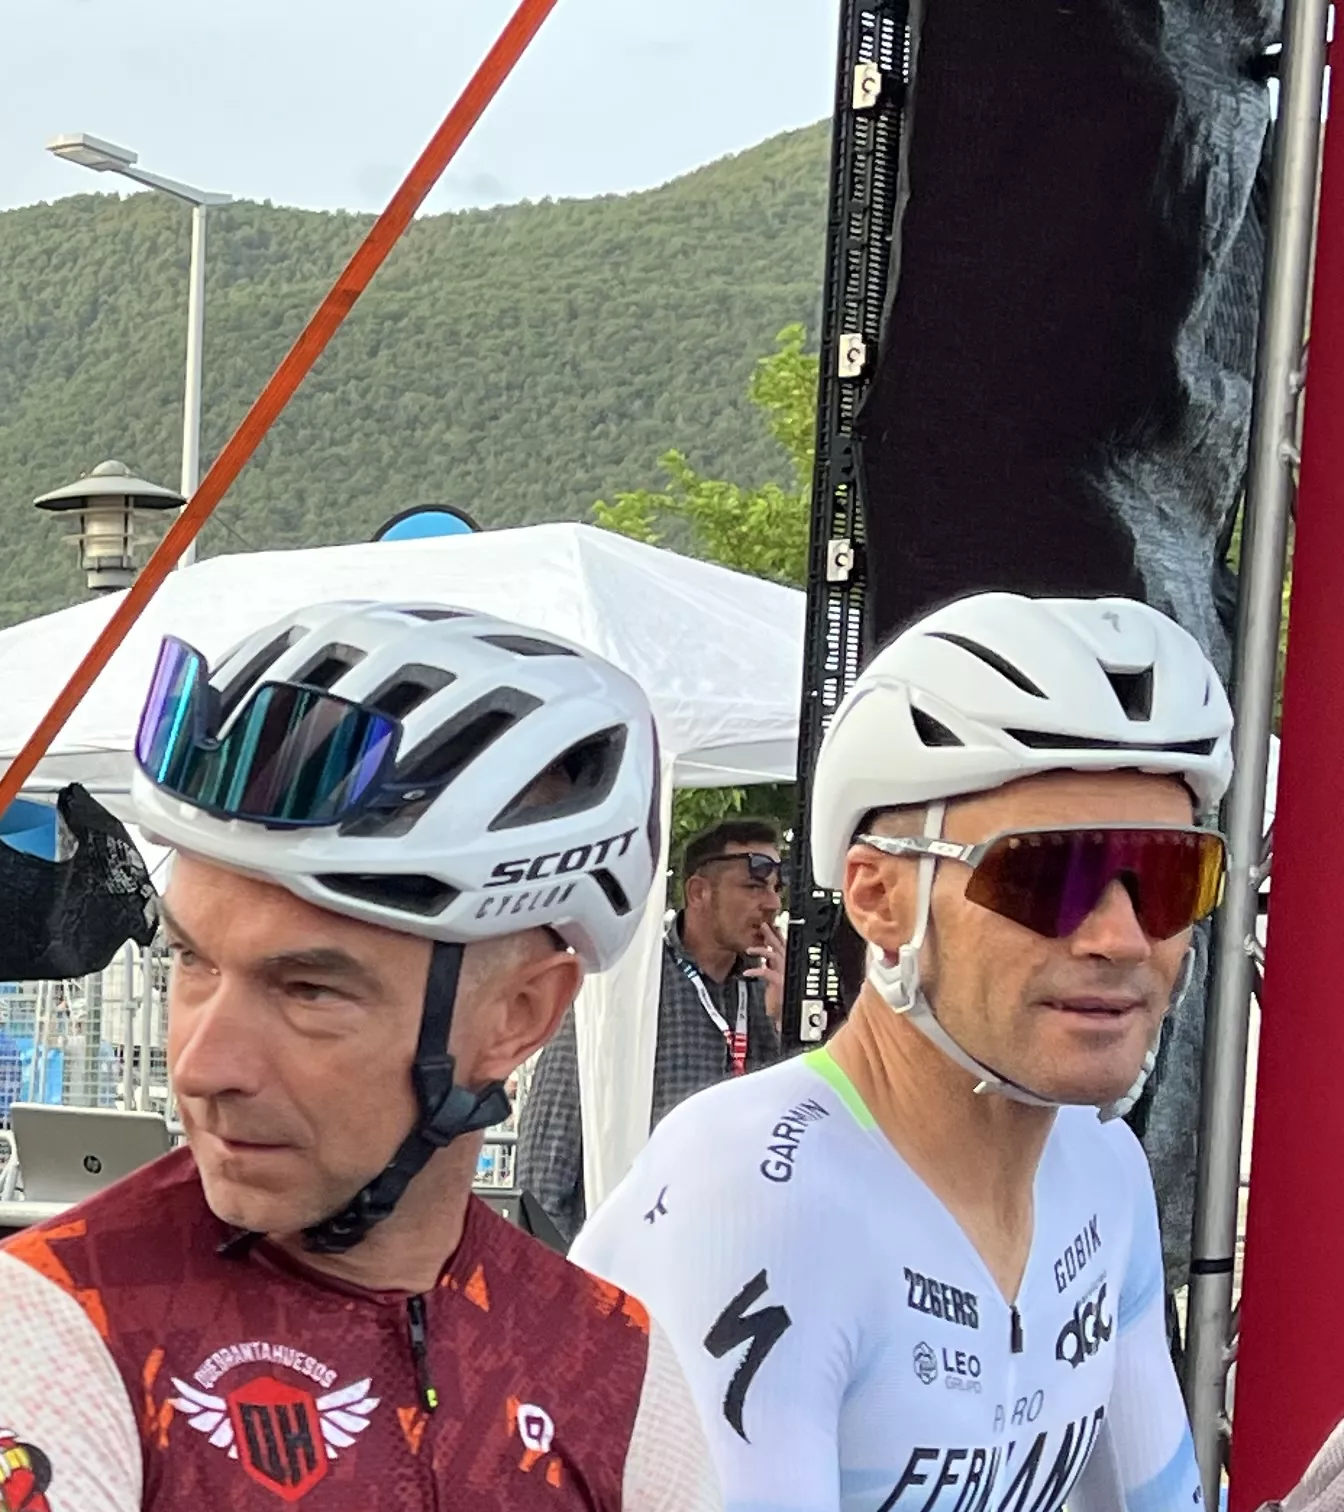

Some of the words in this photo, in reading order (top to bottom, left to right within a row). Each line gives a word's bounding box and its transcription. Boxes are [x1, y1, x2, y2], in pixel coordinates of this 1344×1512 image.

[482, 826, 640, 889] SCOTT
[1053, 1213, 1102, 1294] GOBIK
[942, 1346, 982, 1378] LEO
